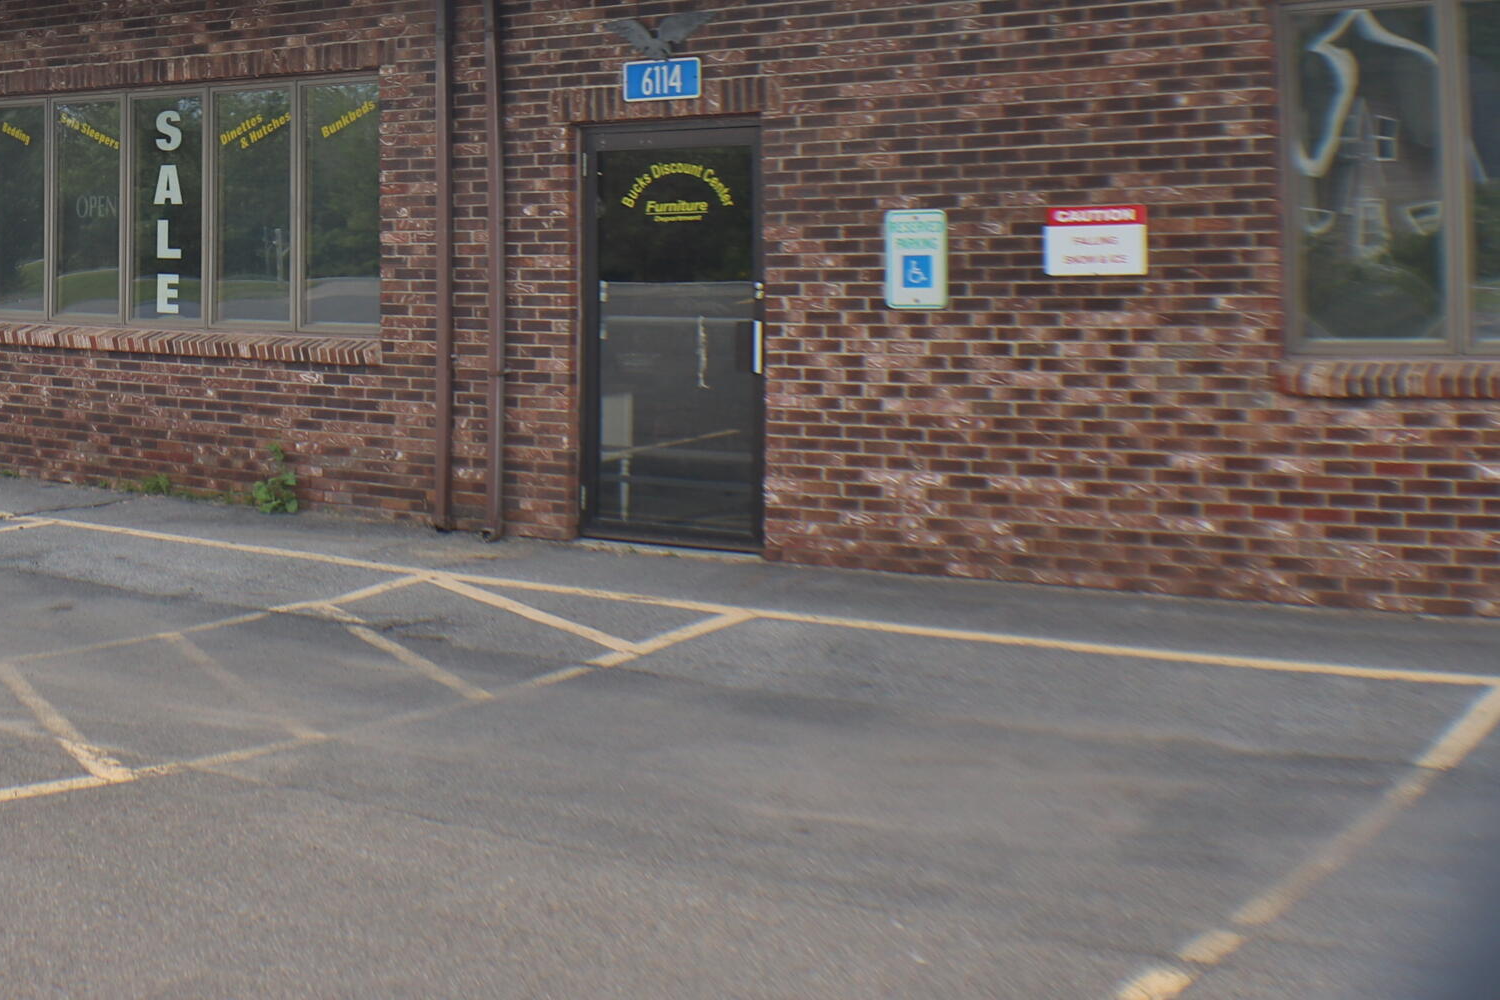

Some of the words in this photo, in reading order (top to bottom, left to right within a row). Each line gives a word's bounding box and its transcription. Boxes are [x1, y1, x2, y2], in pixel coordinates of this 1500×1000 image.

[641, 64, 682, 96] 6114
[2, 122, 31, 146] Bedding
[219, 114, 263, 145] Dinettes
[239, 136, 249, 149] &
[250, 112, 292, 143] Hutches
[320, 101, 377, 139] Bunkbeds
[80, 122, 120, 150] Sleepers
[621, 173, 652, 208] Bucks
[650, 162, 703, 178] Discount
[703, 168, 734, 206] Center
[75, 196, 117, 218] OPEN
[153, 110, 183, 314] SALE
[645, 200, 708, 213] Furniture
[1053, 208, 1137, 222] CAUTION
